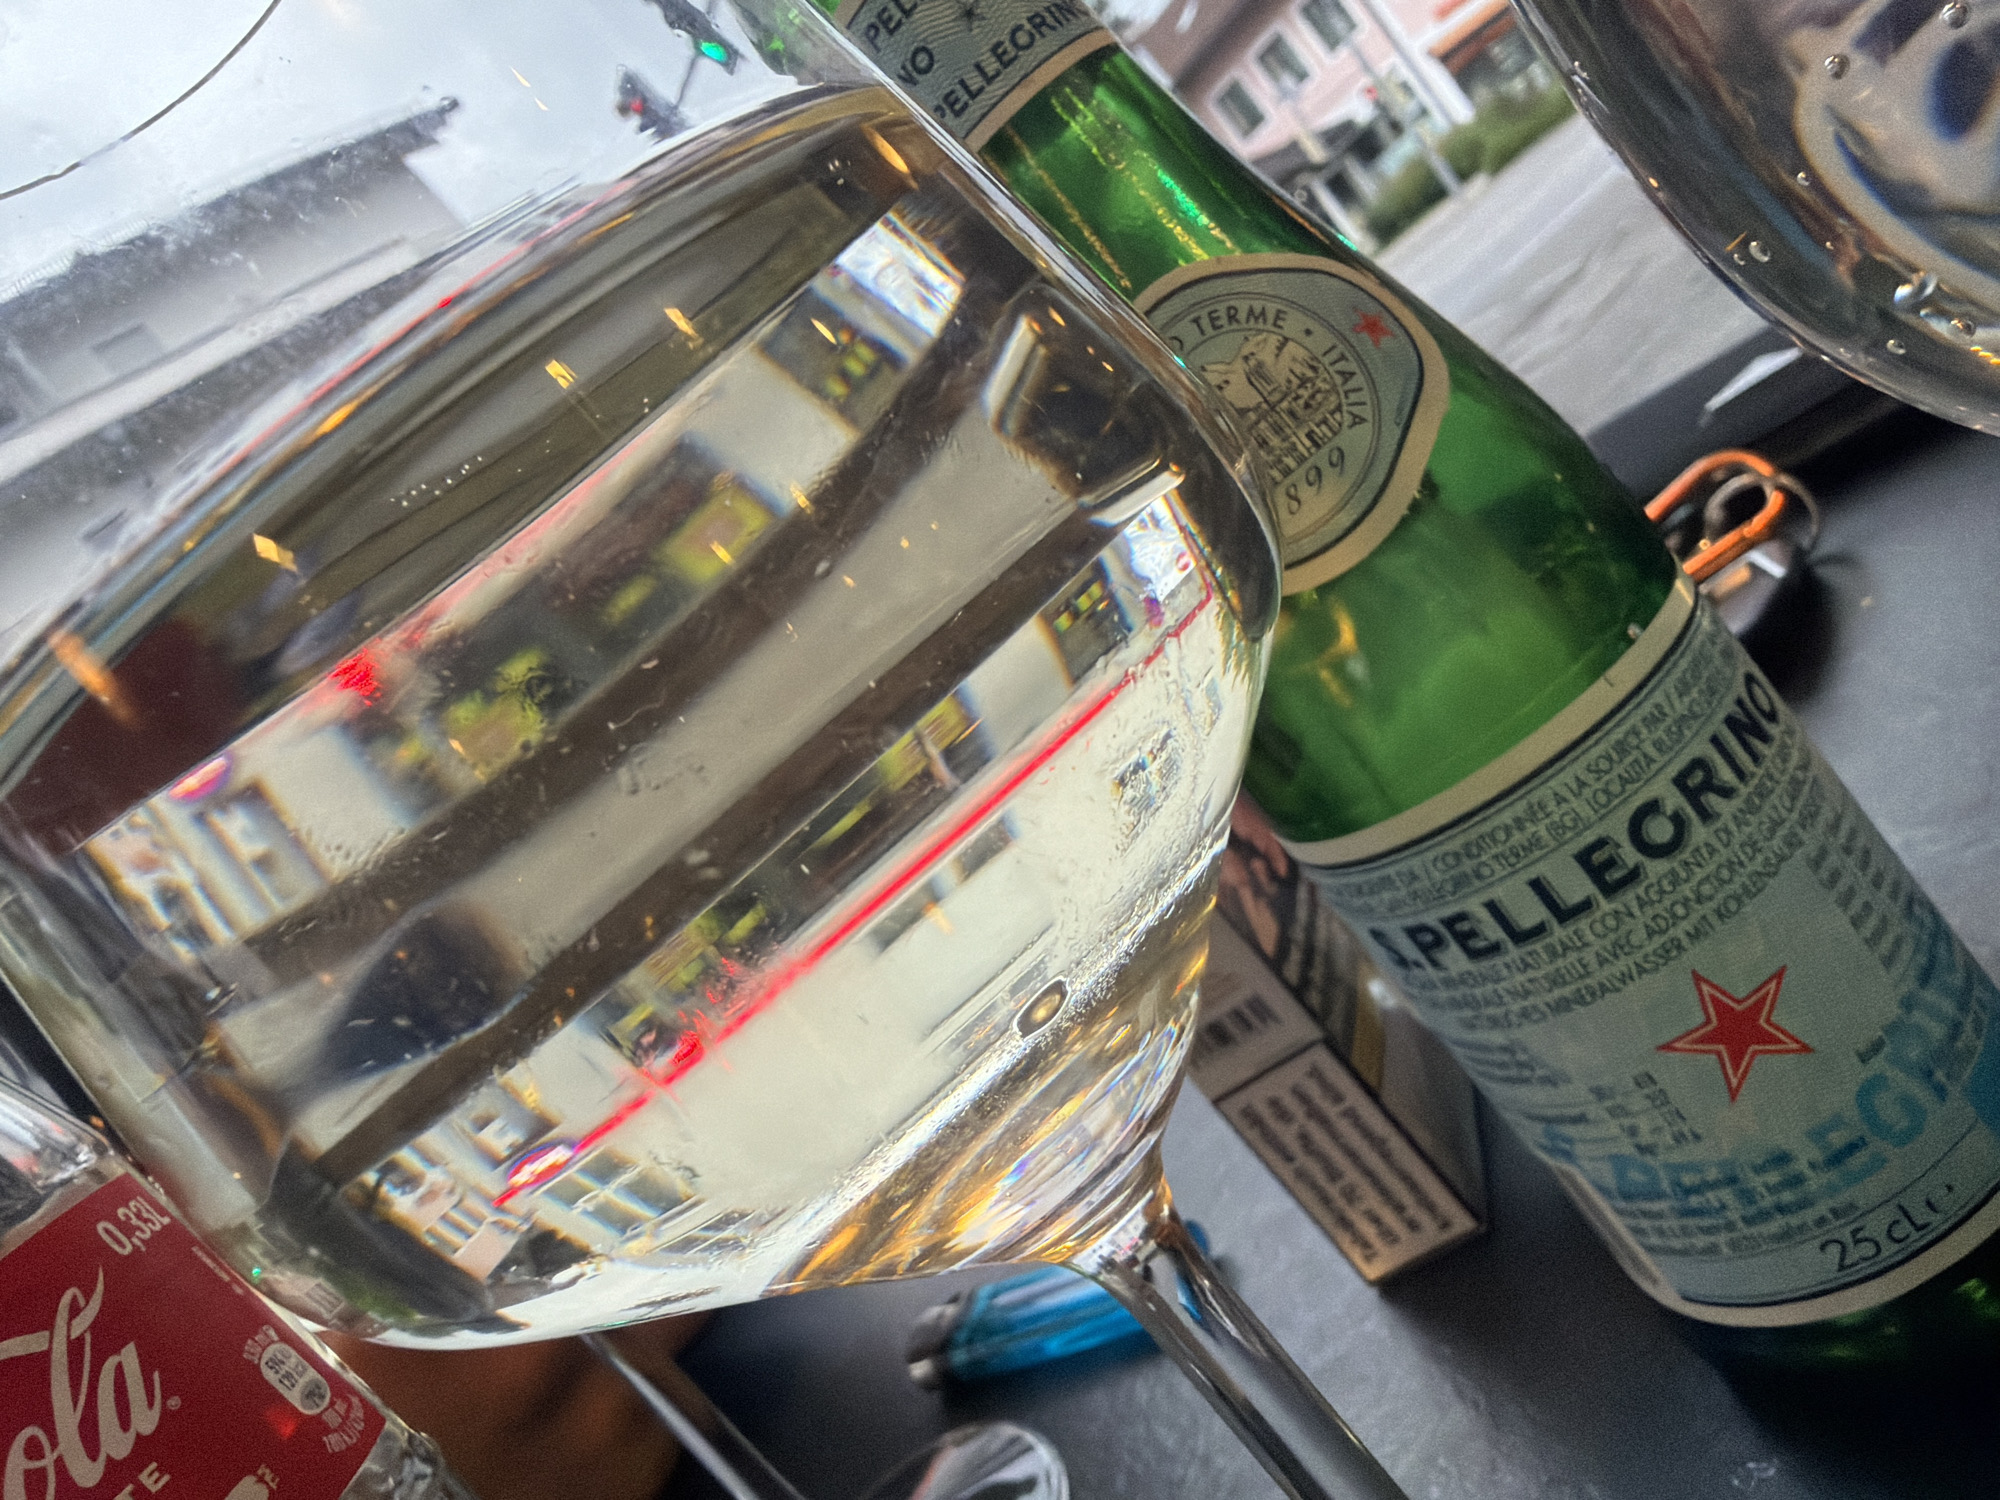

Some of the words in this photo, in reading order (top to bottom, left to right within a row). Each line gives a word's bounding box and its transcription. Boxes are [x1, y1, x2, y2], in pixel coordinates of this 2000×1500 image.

[1189, 305, 1288, 336] TERME
[1322, 344, 1368, 430] ITALIA
[1589, 900, 1637, 939] CON
[96, 1196, 171, 1256] 0,33L
[1819, 1226, 1882, 1272] 25
[0, 1265, 162, 1500] ola
